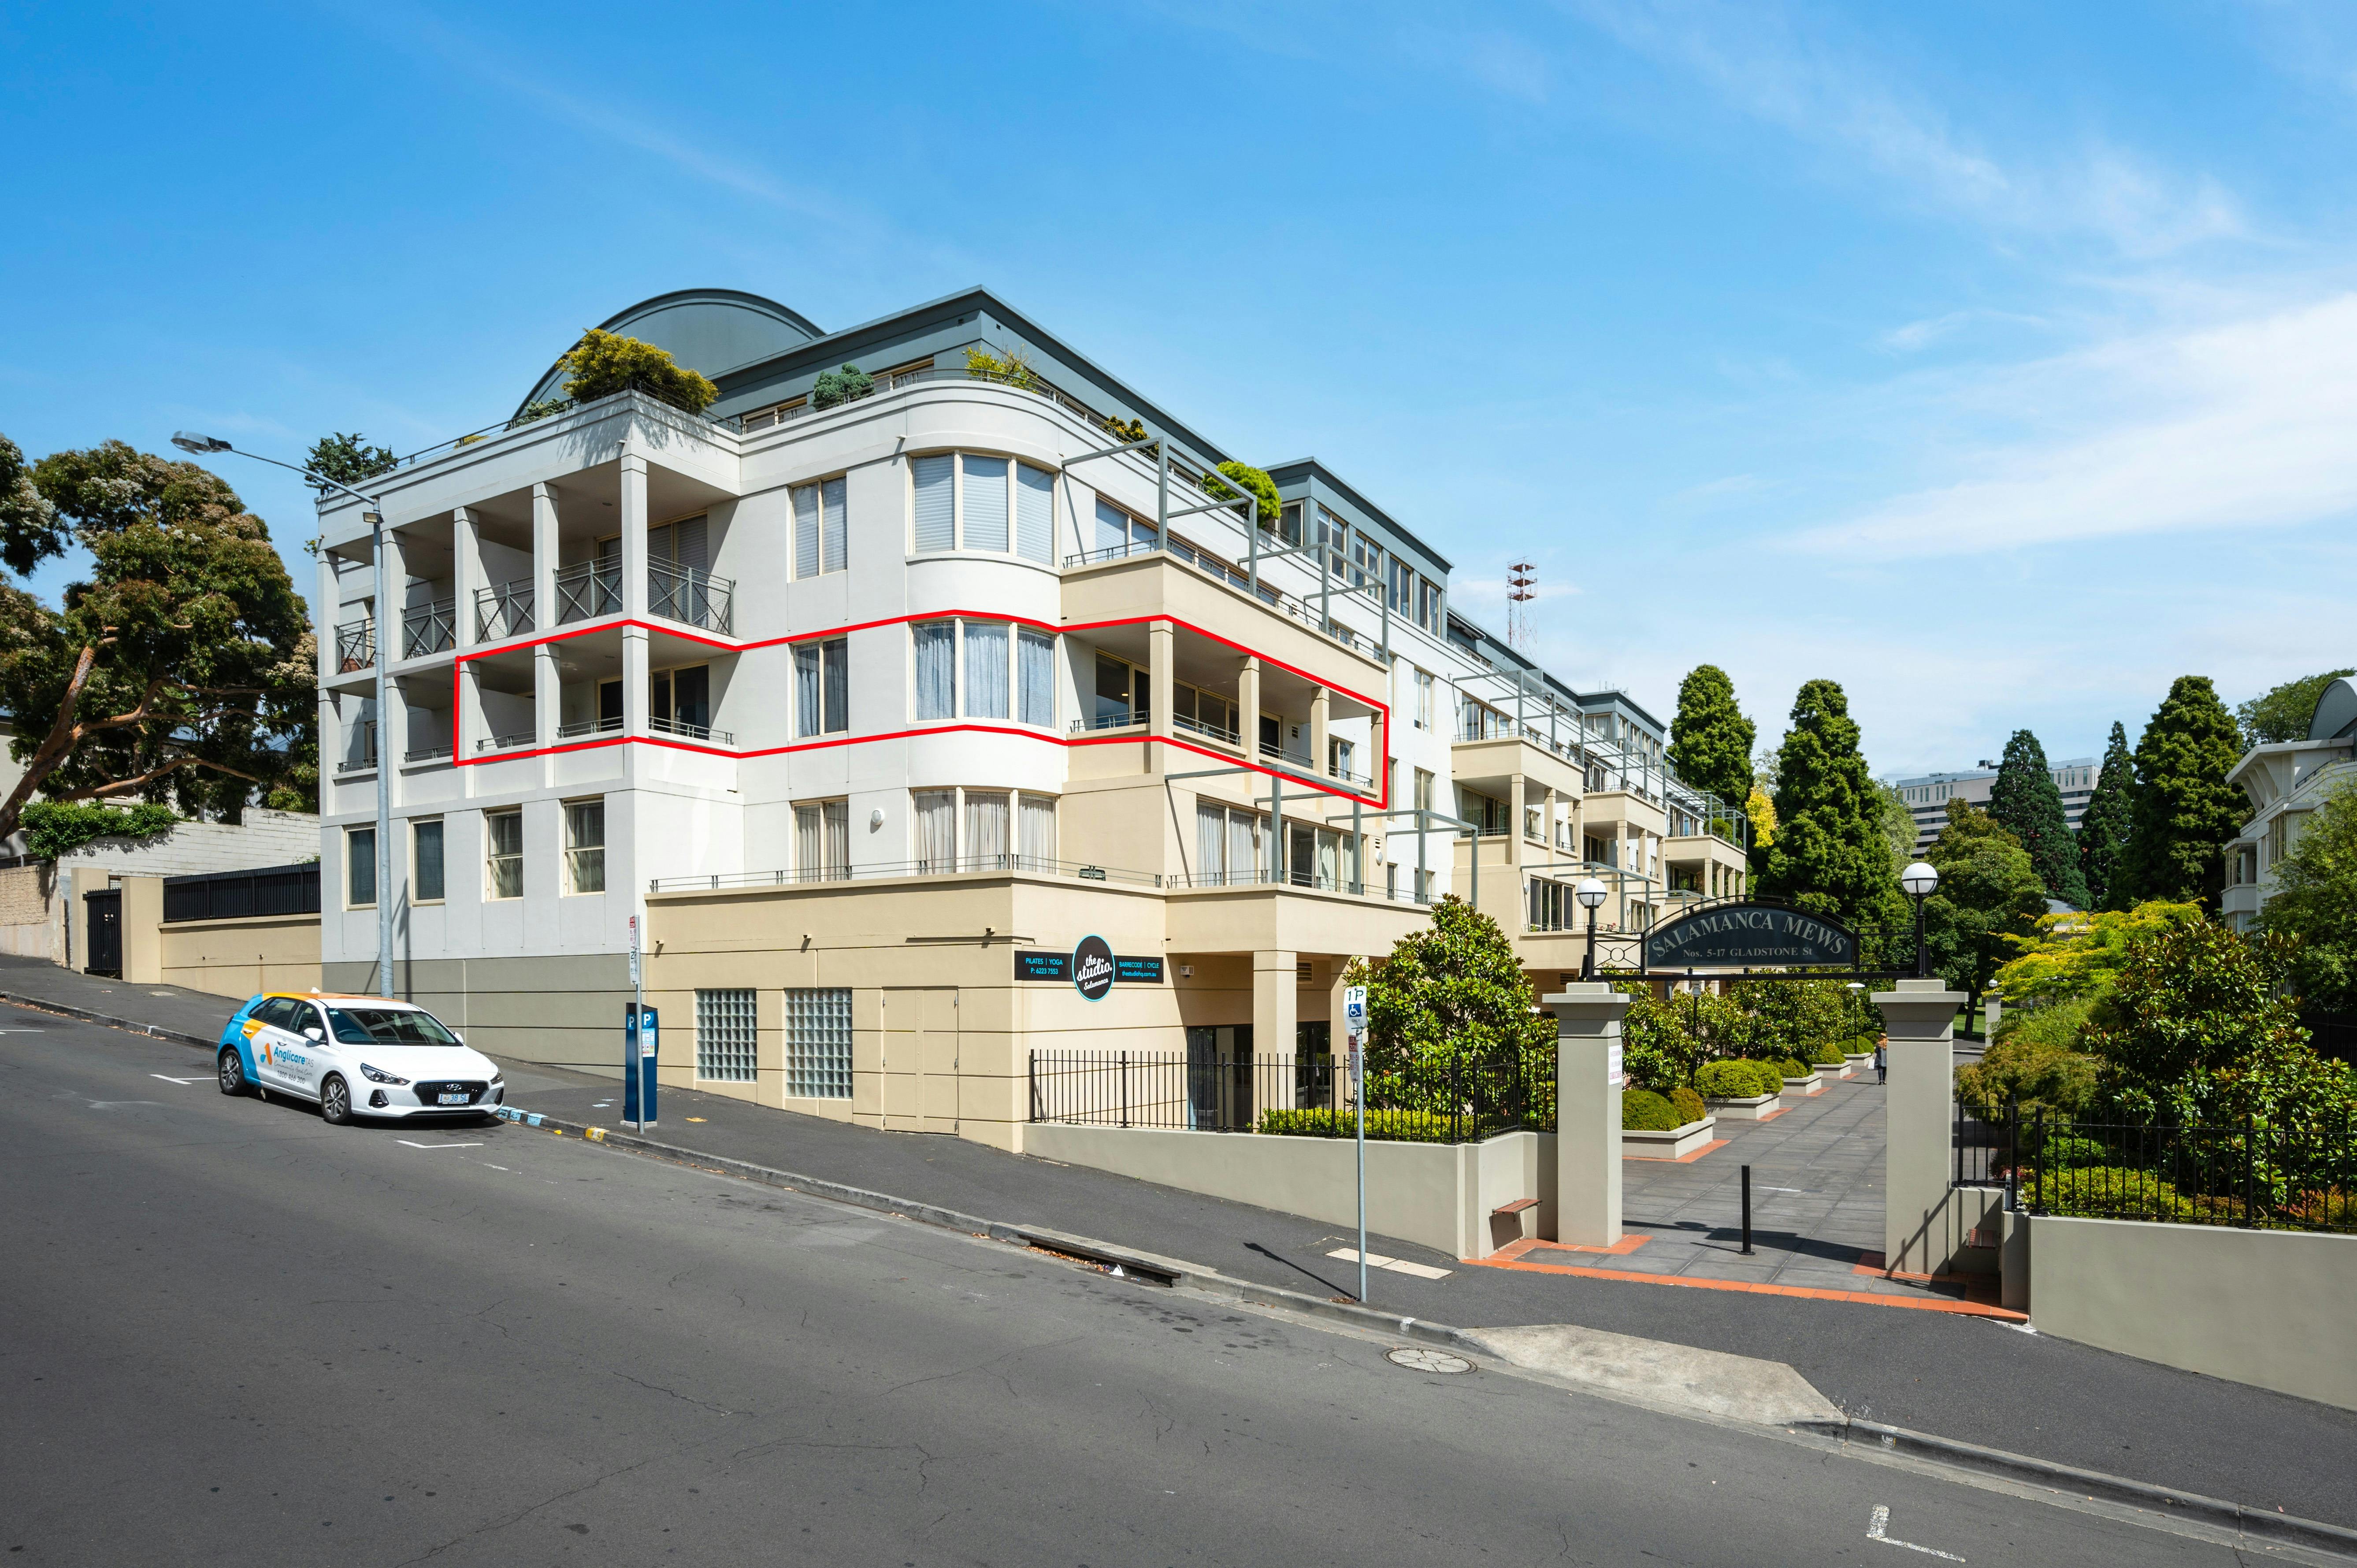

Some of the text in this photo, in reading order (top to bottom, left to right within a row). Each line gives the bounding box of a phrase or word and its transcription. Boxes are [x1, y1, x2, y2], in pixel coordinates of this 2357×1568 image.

[1652, 912, 1847, 958] SALAMANCA MEWS
[1684, 947, 1812, 957] Nos. 5-17 GLADSTONE St
[1086, 954, 1097, 967] the
[1084, 978, 1109, 990] Salamanca
[629, 1016, 635, 1027] P
[644, 1014, 651, 1026] P
